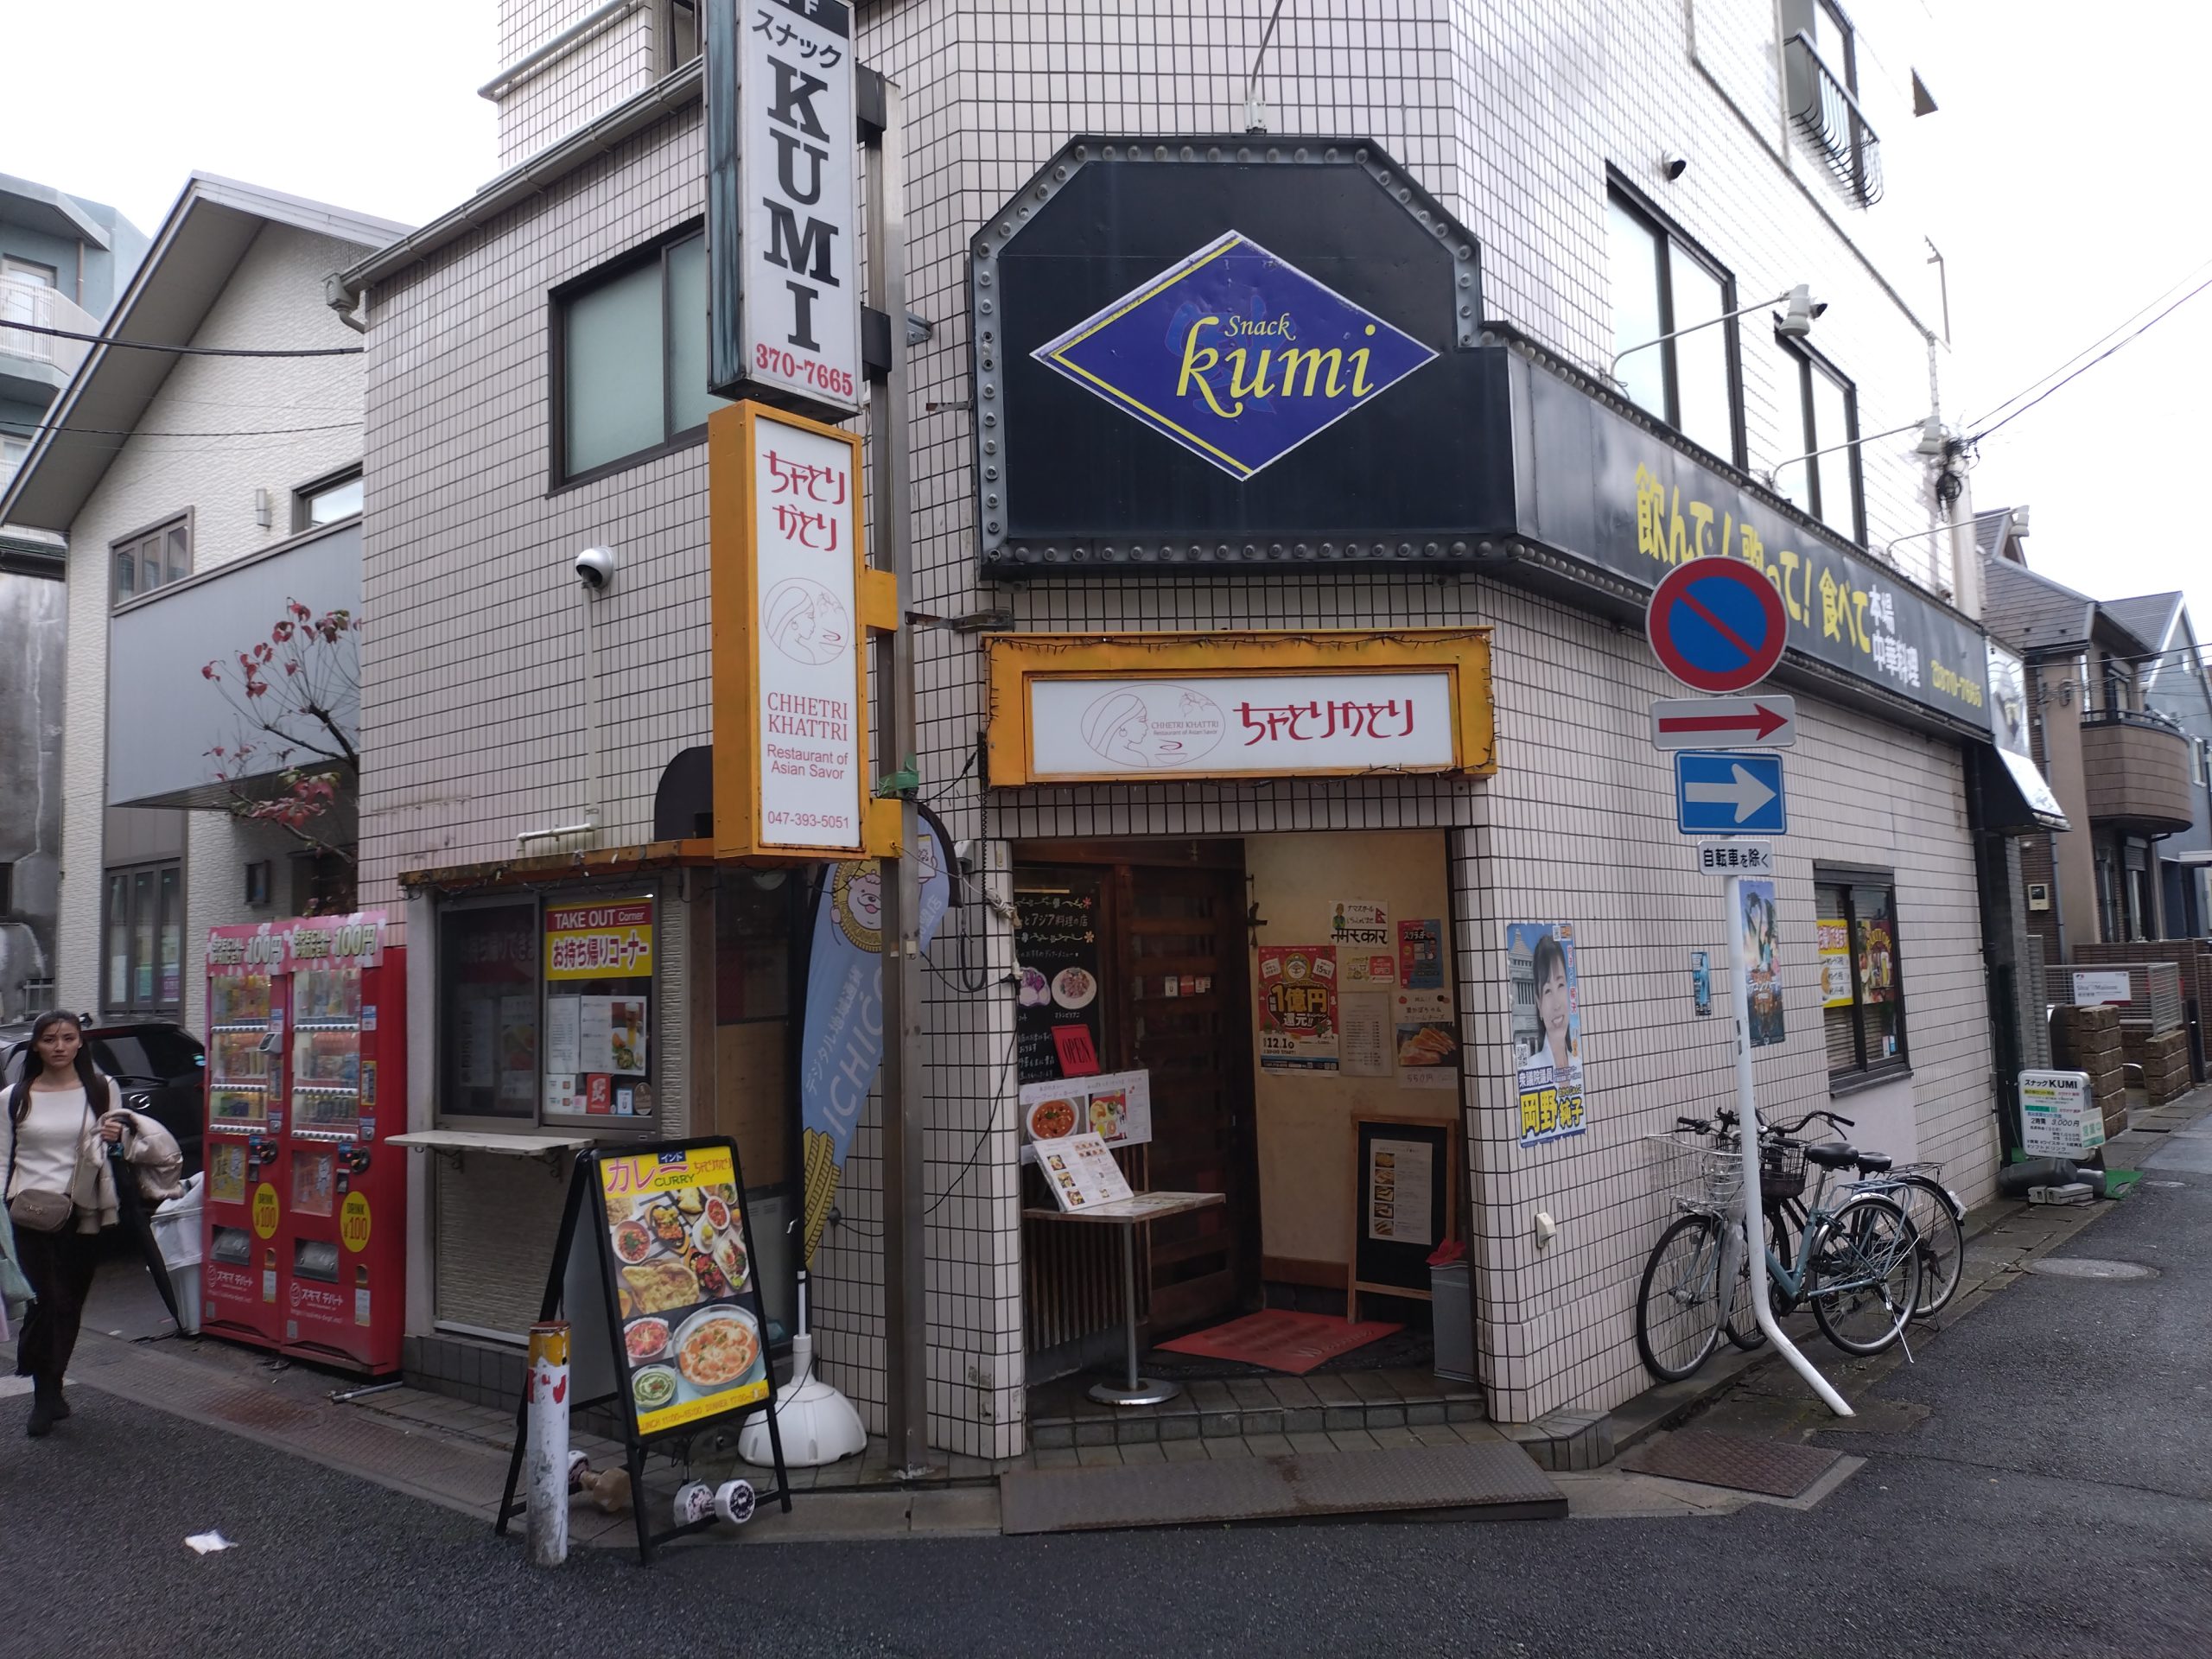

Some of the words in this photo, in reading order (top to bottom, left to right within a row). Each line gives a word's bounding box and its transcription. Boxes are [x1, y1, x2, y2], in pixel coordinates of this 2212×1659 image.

[753, 10, 842, 69] スナック
[763, 54, 840, 353] KUMI
[1224, 313, 1295, 340] Snack
[756, 344, 853, 397] 370-7665
[1176, 316, 1376, 417] kumi
[768, 692, 849, 721] CHHETRI
[768, 715, 849, 741] KHATTRI
[768, 743, 833, 765] Restaurant
[836, 753, 849, 766] of
[772, 760, 806, 777] Asian
[810, 764, 844, 780] Savor
[768, 810, 849, 830] 047-393-5051
[1703, 848, 1770, 869] 自転車を除く
[555, 911, 586, 929] TAKE
[588, 909, 616, 926] OUT
[618, 911, 645, 922] Corner
[247, 934, 283, 964] 100円
[334, 924, 378, 957] 100円
[552, 930, 648, 969] お持ち帰りコーナー
[1330, 928, 1389, 944] नमस्कार
[1271, 984, 1328, 1013] 1億円
[1062, 1037, 1092, 1065] OPEN
[1519, 1067, 1553, 1089] 衆議院議員
[1520, 1086, 1584, 1139] 岡野純子
[660, 1153, 684, 1164] インド
[606, 1158, 689, 1194] カレー
[654, 1173, 696, 1187] CURRY
